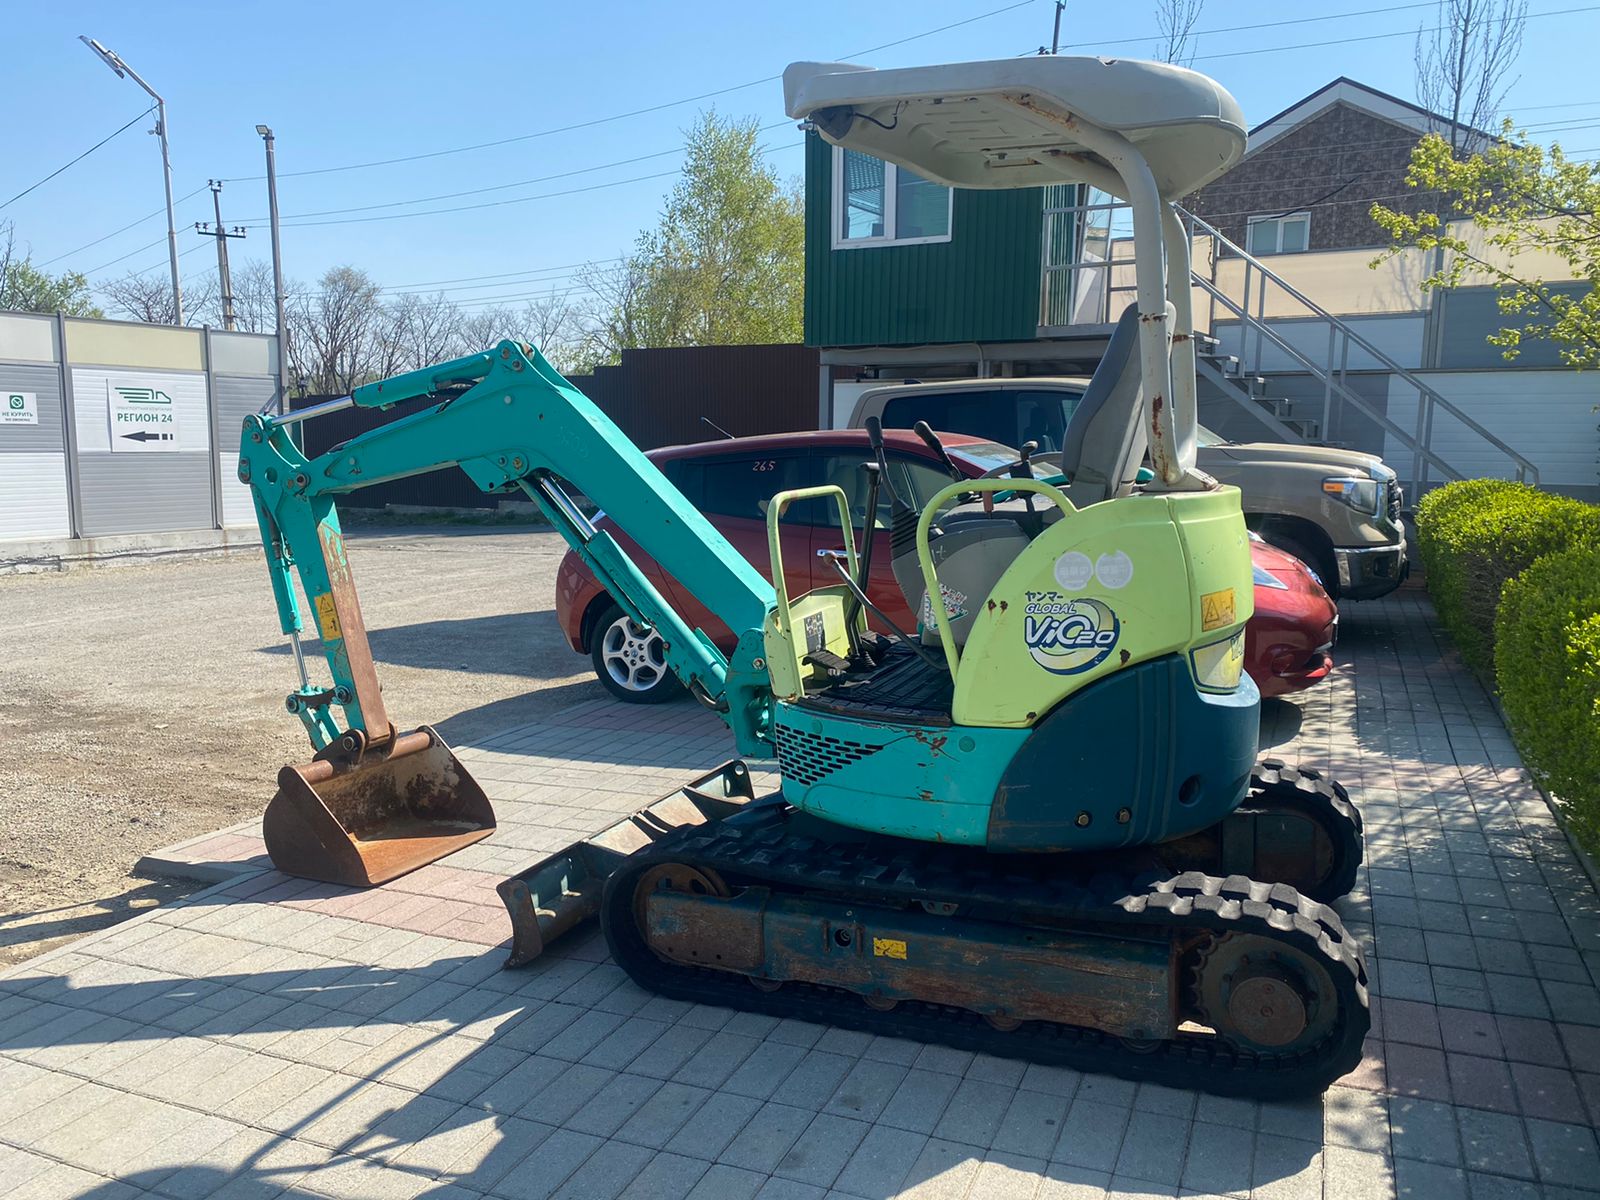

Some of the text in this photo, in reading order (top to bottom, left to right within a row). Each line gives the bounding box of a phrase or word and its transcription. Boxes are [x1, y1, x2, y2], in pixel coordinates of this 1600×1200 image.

[117, 413, 173, 423] РЕГИОН 24
[1025, 591, 1063, 602] ヤンマー
[1025, 603, 1077, 614] GLOBAL
